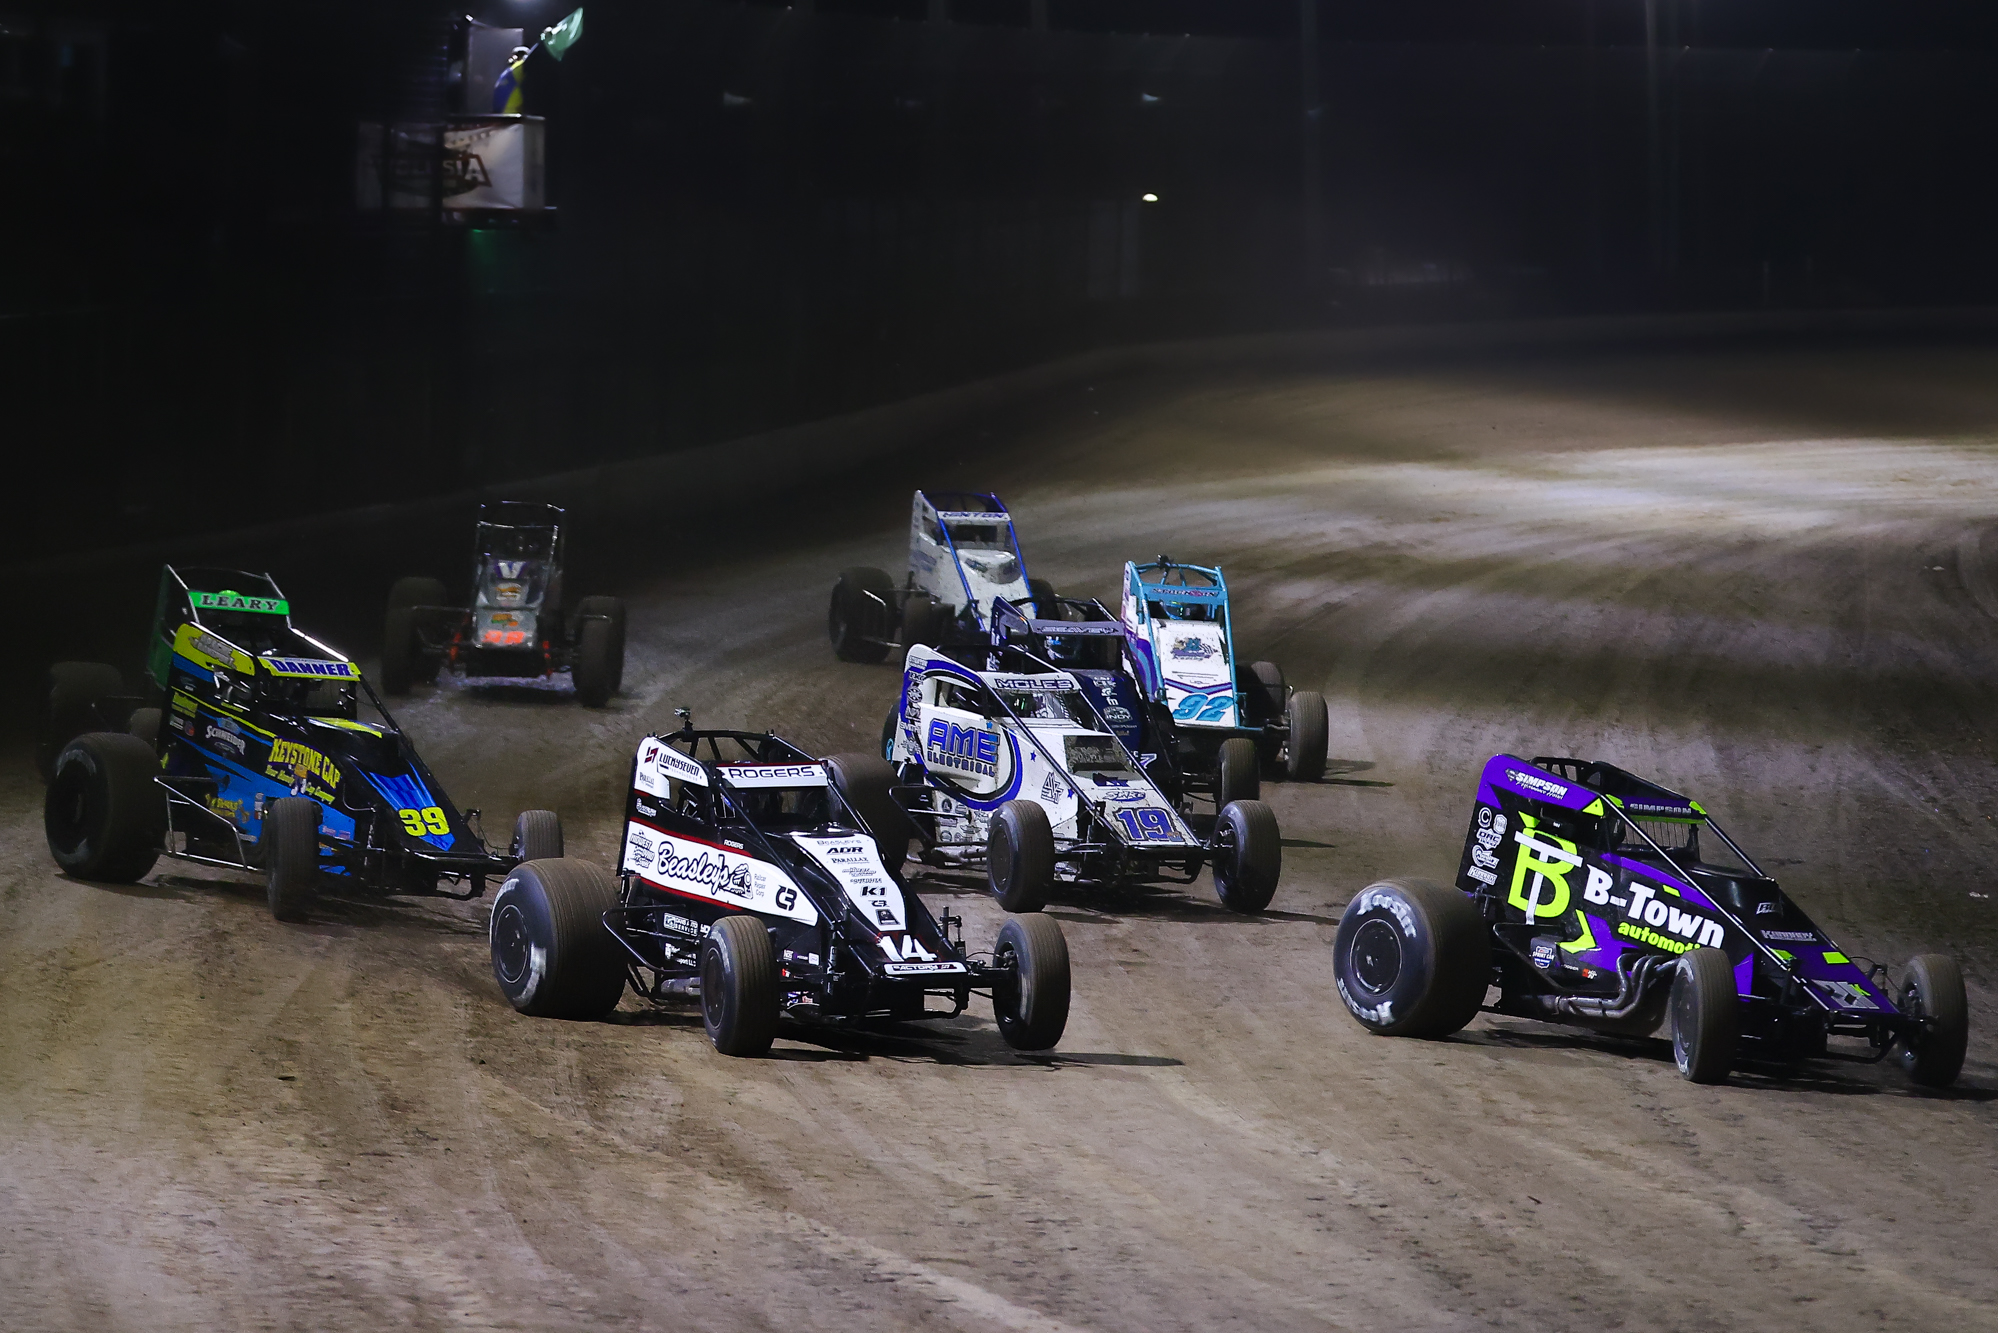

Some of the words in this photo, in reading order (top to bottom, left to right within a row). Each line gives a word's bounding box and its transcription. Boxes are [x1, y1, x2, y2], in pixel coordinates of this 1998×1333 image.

[200, 594, 279, 612] LEARY
[268, 659, 351, 676] DANNER
[995, 679, 1074, 690] MOLES
[1172, 694, 1234, 722] 92
[927, 718, 1000, 766] AME
[268, 738, 323, 776] KEYSTONE
[321, 756, 341, 789] CAP
[728, 766, 815, 778] ROGERS
[927, 751, 996, 777] ELECTRICAL
[1515, 772, 1568, 796] SIMPSON
[399, 807, 450, 837] 39
[1630, 803, 1692, 814] SIMPSON
[1113, 808, 1184, 842] 19
[724, 839, 744, 850] ROGERS
[1583, 863, 1725, 949] B-Town
[876, 934, 938, 962] 14
[1617, 921, 1701, 955] automot
